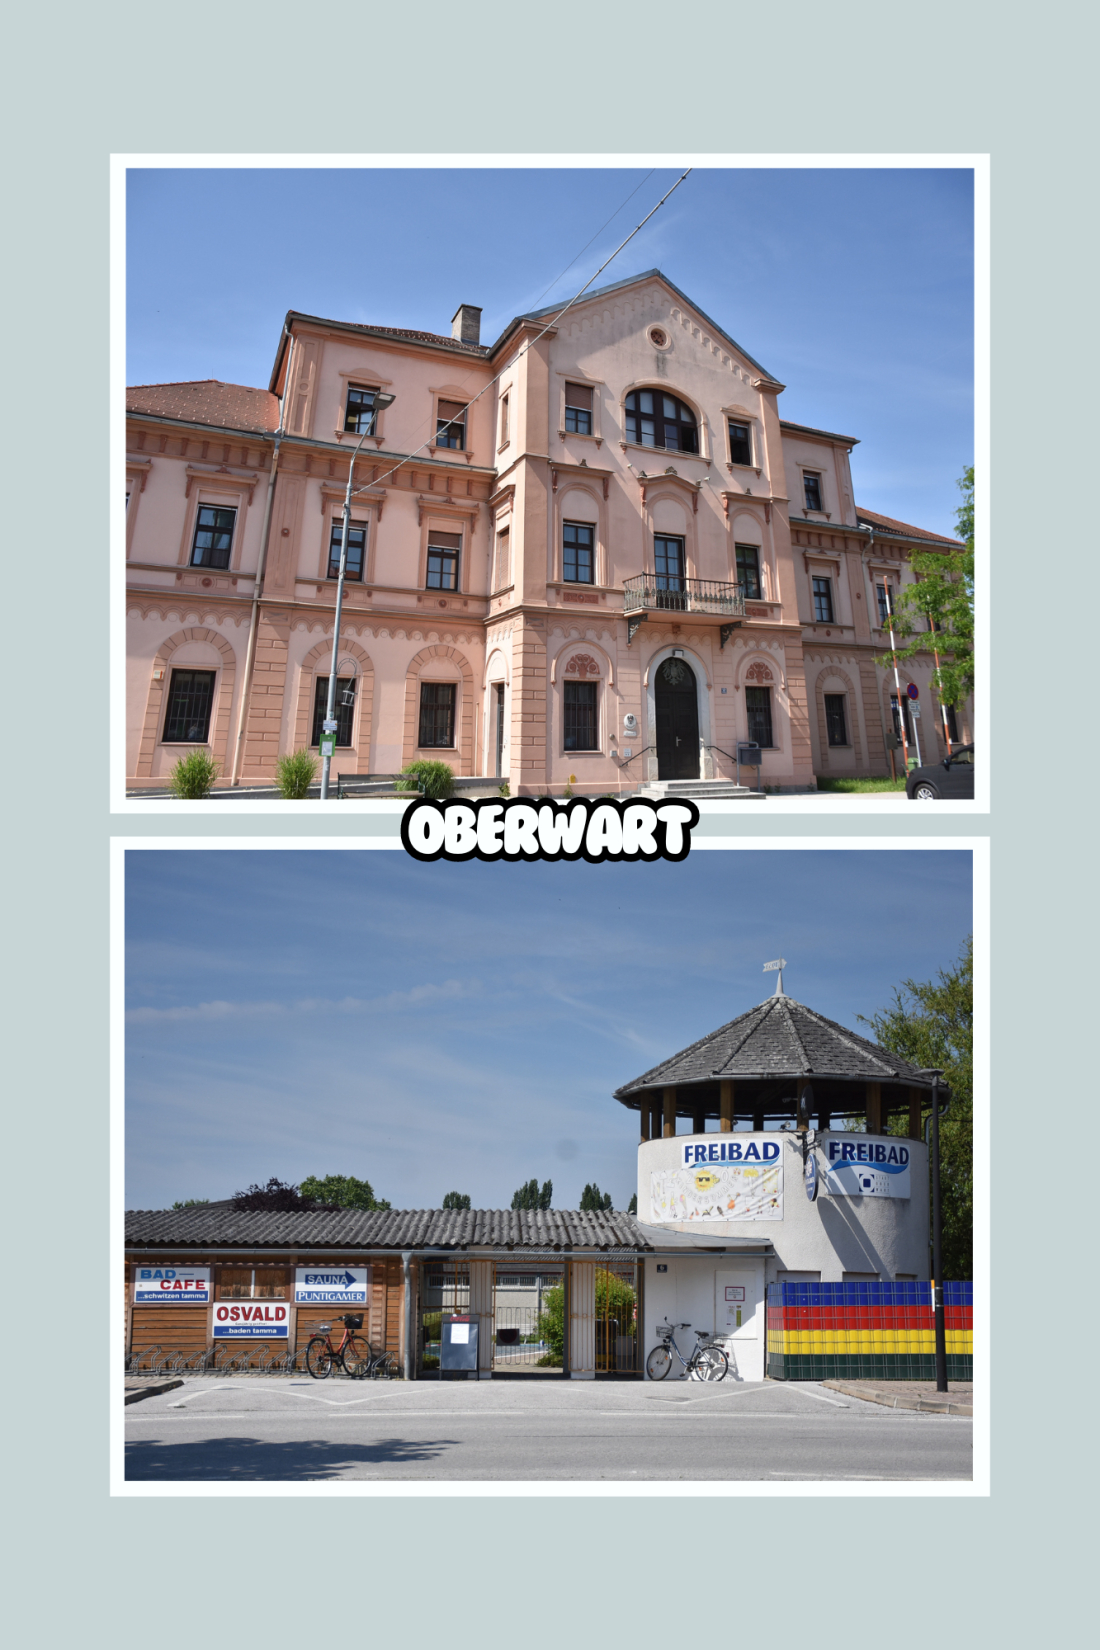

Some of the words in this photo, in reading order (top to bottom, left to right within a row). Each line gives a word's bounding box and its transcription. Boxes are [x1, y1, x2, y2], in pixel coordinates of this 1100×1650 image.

[684, 1142, 780, 1164] FREIBAD
[828, 1141, 909, 1166] FREIBAD
[140, 1269, 177, 1279] BAD
[307, 1275, 349, 1284] SAUNA
[160, 1279, 206, 1290] CAFE
[298, 1291, 363, 1301] PUNTIGAMER
[216, 1306, 286, 1321] OSVALD
